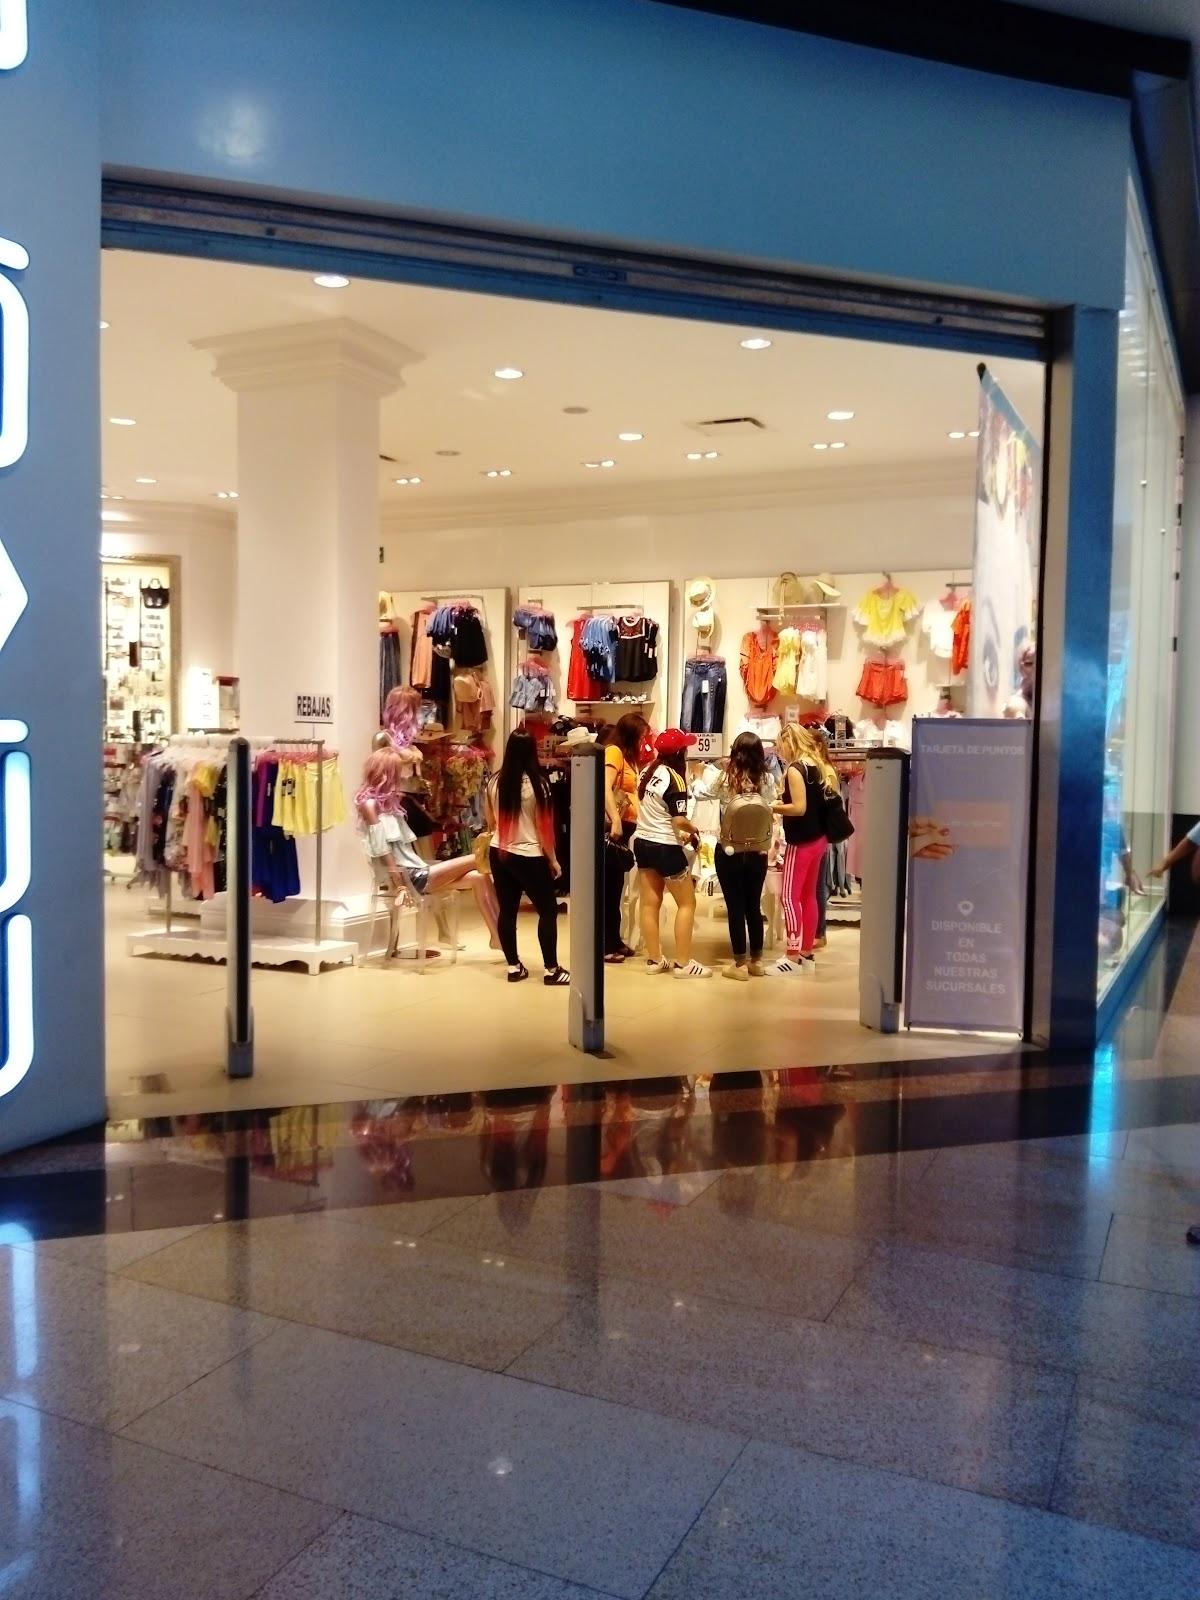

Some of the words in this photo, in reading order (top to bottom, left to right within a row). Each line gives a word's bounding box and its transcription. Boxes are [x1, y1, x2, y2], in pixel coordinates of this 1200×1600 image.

[297, 695, 331, 717] REBAJAS
[698, 738, 710, 752] 59
[920, 744, 965, 754] TARJETA
[967, 745, 979, 754] DE
[982, 745, 1025, 755] PUNTOS
[931, 919, 1003, 934] DISPONIBLE
[959, 937, 975, 948] EN
[945, 951, 987, 964] TODAS
[933, 966, 999, 979] NUESTRAS
[926, 980, 1007, 994] SUCURSALES
